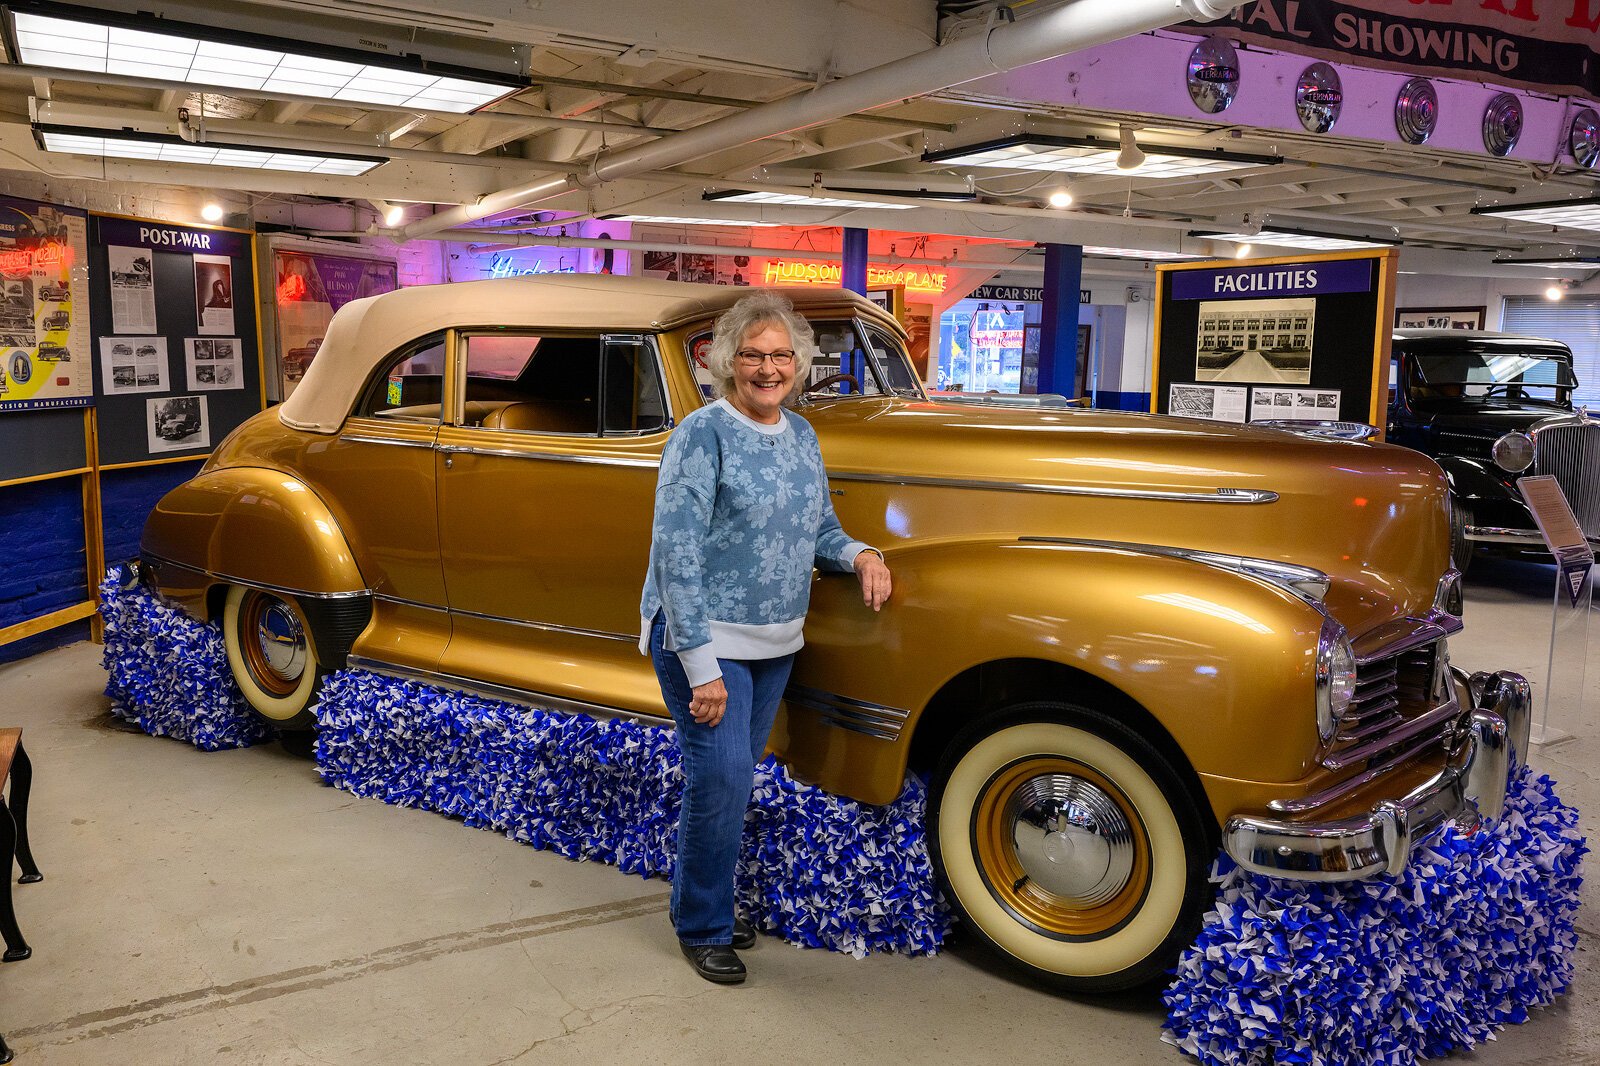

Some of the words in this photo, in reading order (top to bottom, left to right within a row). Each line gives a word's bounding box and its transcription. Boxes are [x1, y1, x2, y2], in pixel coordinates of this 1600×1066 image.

[1236, 0, 1312, 38] AL
[1333, 12, 1519, 72] SHOWING
[140, 227, 211, 249] POST-WAR
[765, 261, 841, 284] HUDSON
[867, 268, 948, 290] ERRAPLANE
[1214, 269, 1318, 293] FACILITIES
[995, 287, 1020, 300] CAR
[34, 399, 87, 408] MANUFACTURE
